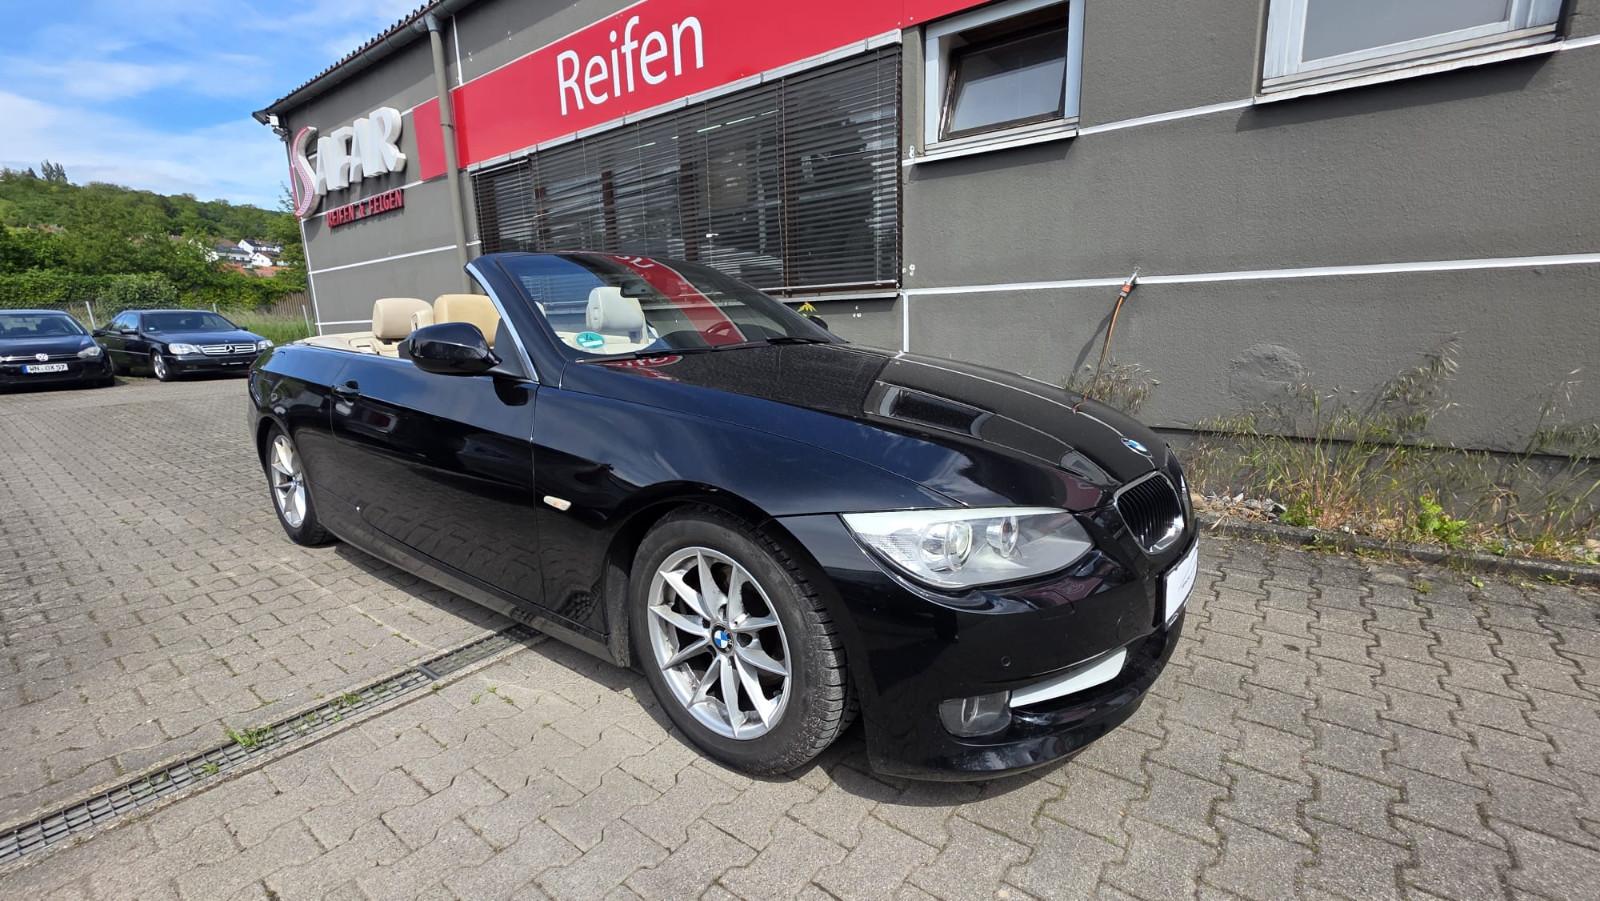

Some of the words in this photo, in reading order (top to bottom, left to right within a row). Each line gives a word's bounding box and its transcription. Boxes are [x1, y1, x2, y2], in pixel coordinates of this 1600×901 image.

[557, 16, 704, 116] Reifen
[327, 203, 354, 227] REIFEN
[359, 201, 367, 217] &
[368, 189, 404, 214] FELGEN
